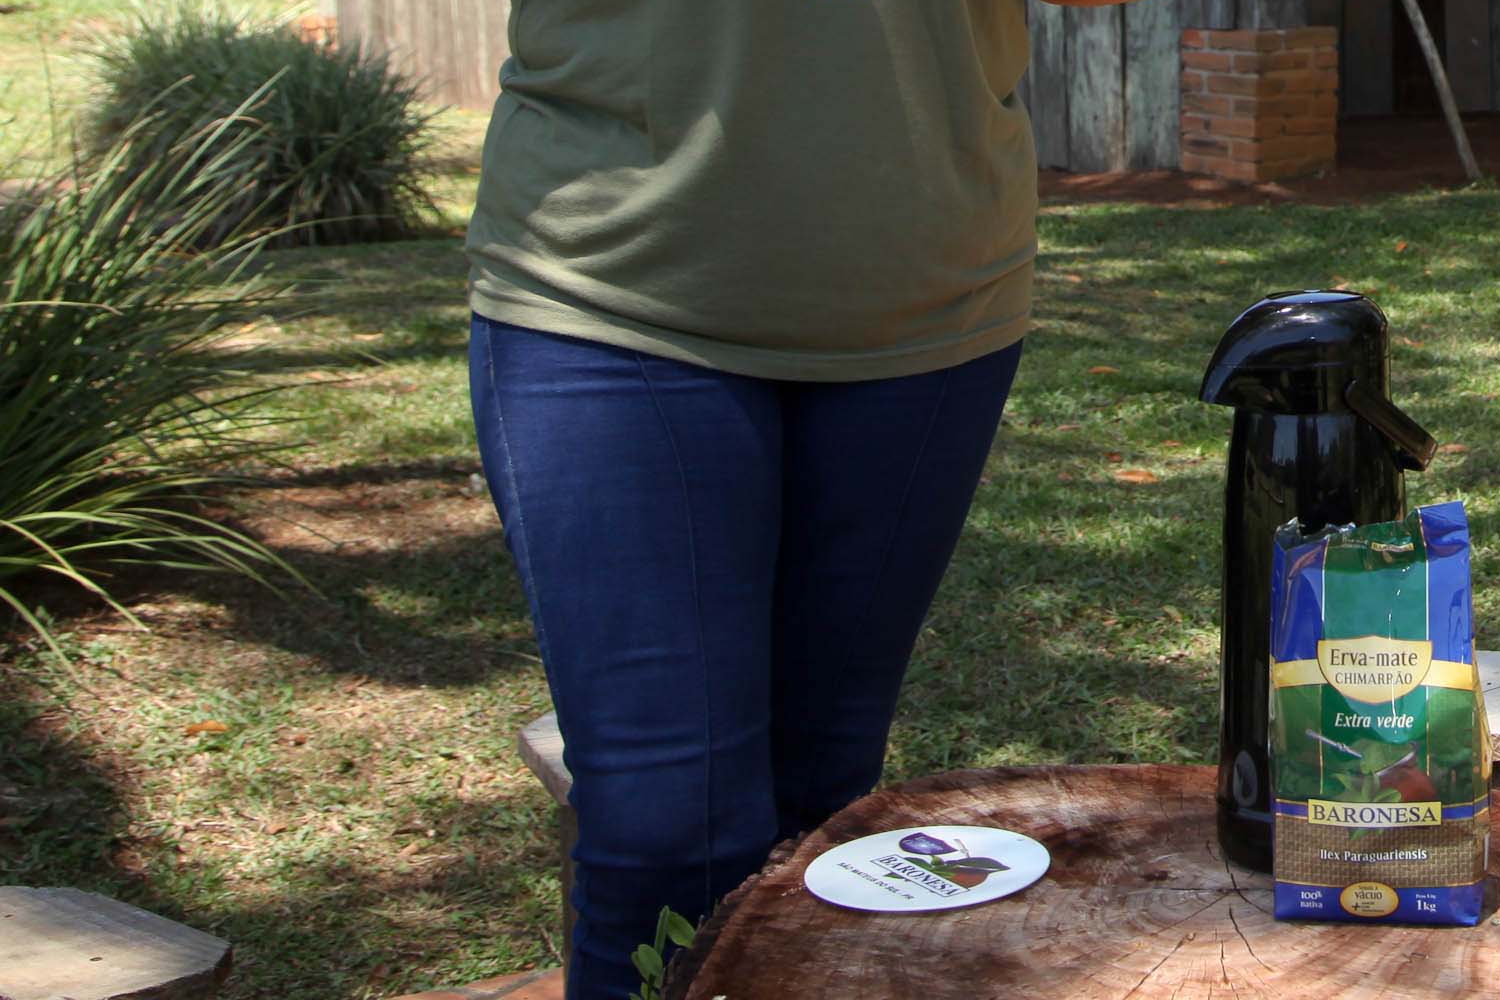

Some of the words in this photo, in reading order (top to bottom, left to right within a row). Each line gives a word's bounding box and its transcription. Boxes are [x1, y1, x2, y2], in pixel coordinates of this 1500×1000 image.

[1330, 648, 1419, 666] Erva-mate
[1335, 671, 1413, 685] CHIMARRÃO
[1334, 712, 1371, 727] Extra
[1377, 713, 1414, 728] verde
[1312, 804, 1438, 823] BARONESA
[1344, 849, 1428, 862] Paraguariensis
[880, 855, 960, 896] BARONESA
[1300, 890, 1322, 900] 100%
[1300, 900, 1323, 908] nativa
